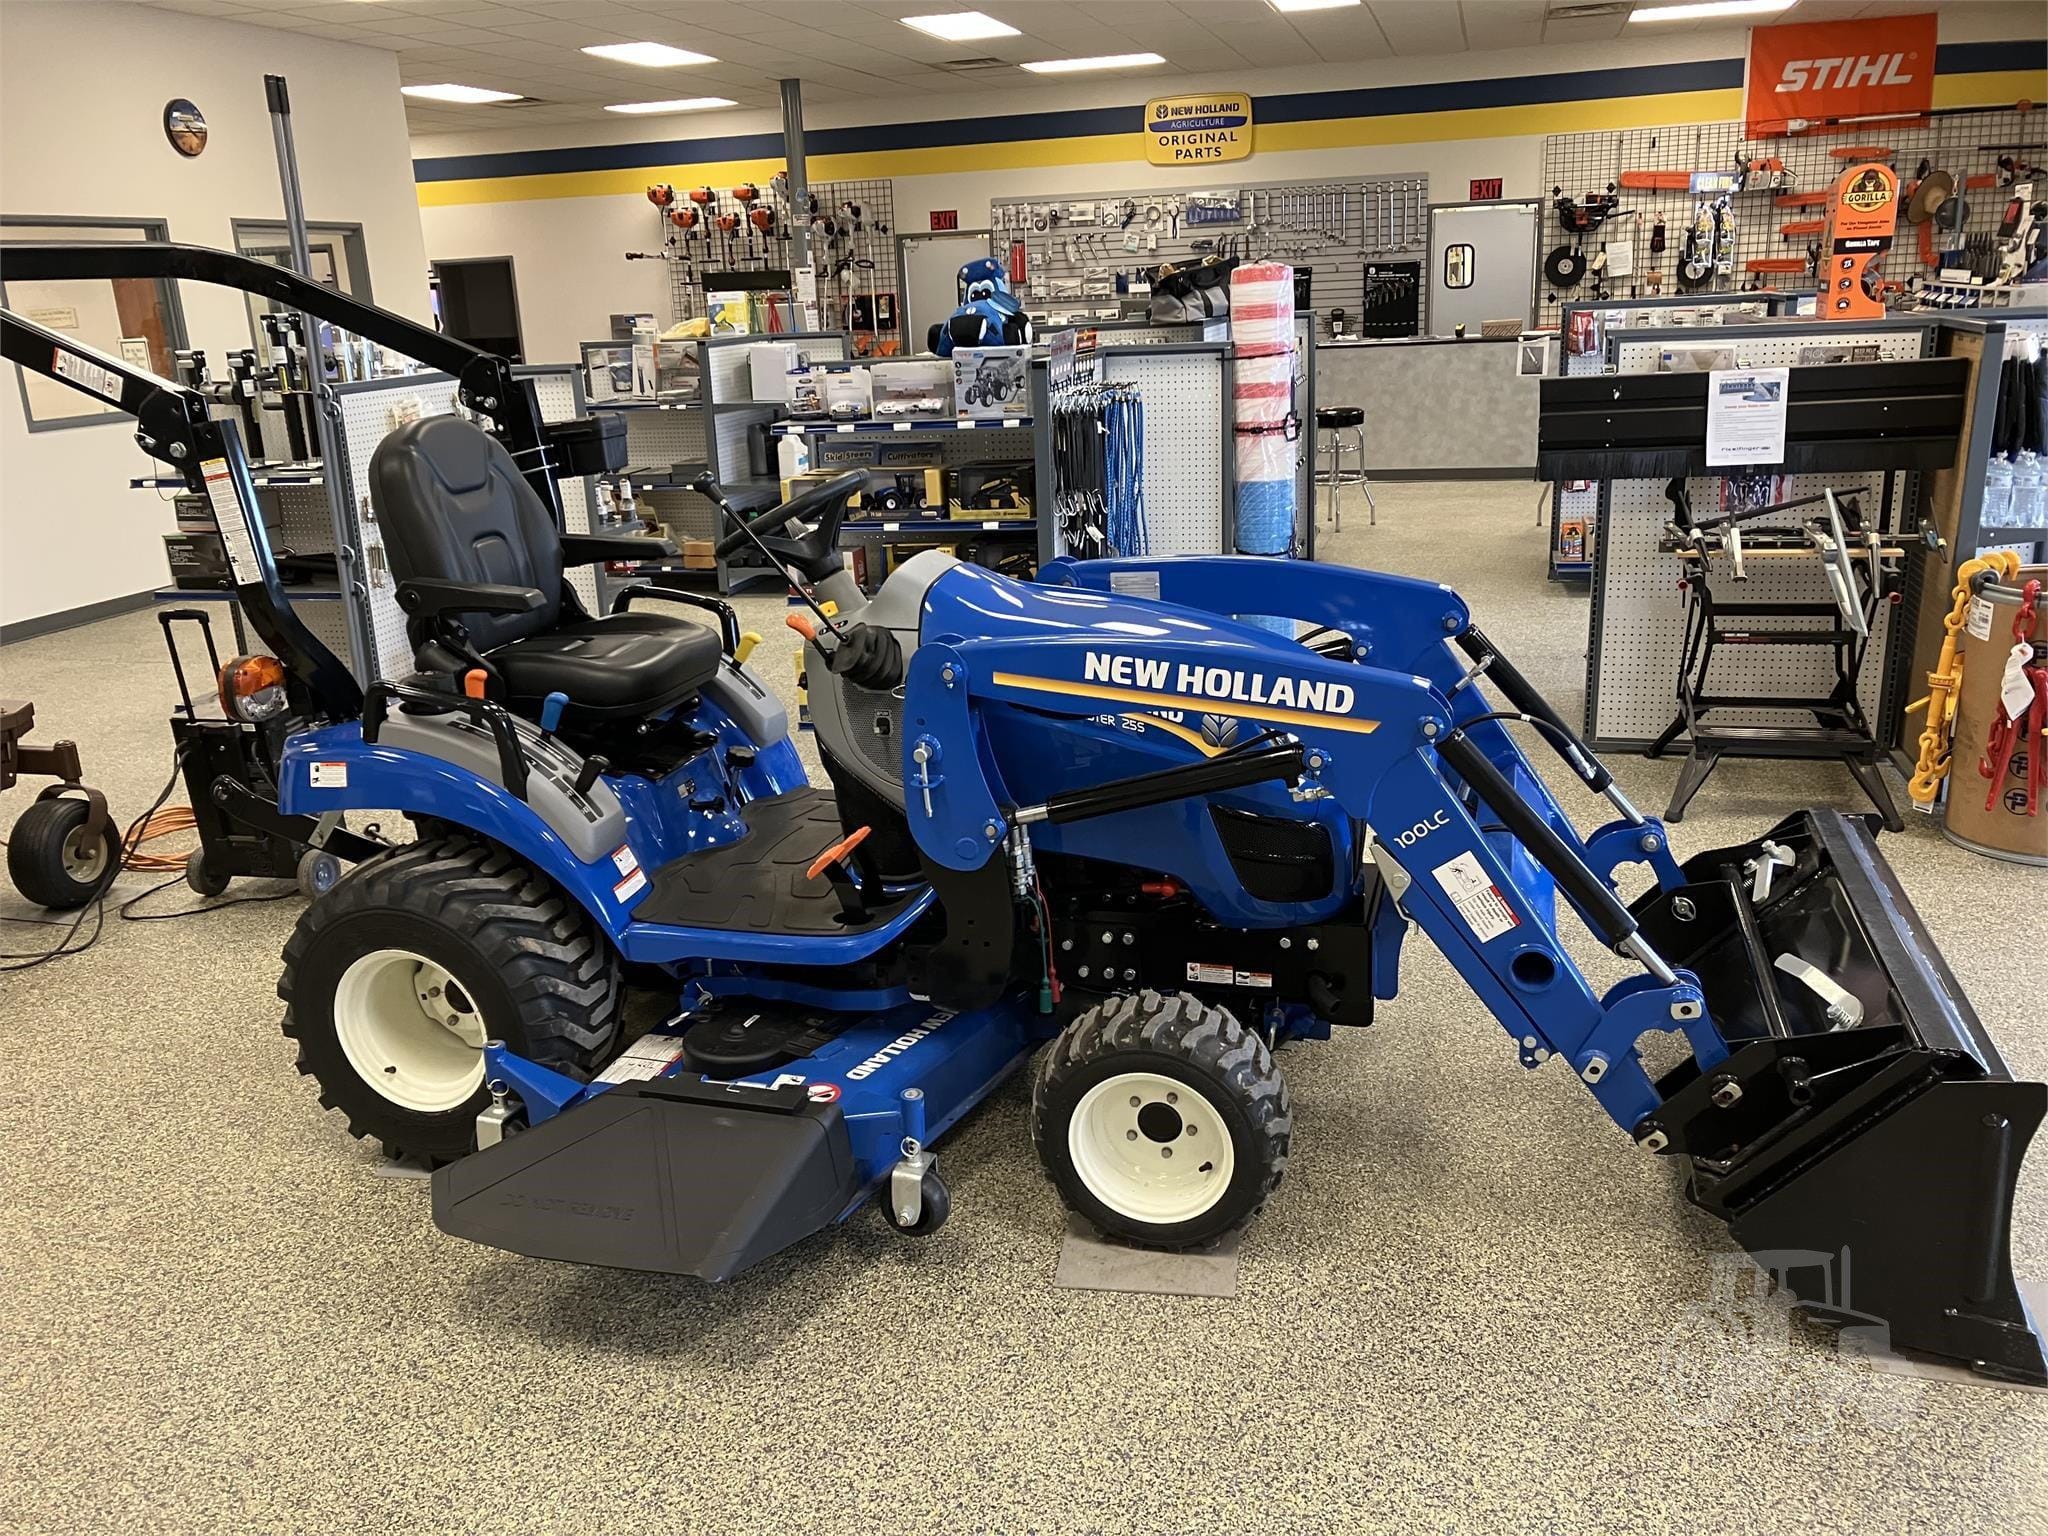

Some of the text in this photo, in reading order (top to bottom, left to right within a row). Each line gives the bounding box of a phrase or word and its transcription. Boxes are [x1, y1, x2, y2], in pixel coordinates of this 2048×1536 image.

[1775, 53, 1913, 93] STIHL
[1171, 103, 1240, 117] NEW HOLLAND
[1170, 118, 1225, 129] AGRICULTURE
[1159, 131, 1238, 147] ORIGINAL
[1175, 146, 1222, 160] PARTS
[1471, 179, 1502, 200] EXIT
[1847, 192, 1888, 203] GORILLA
[931, 211, 957, 230] EXIT
[824, 450, 874, 462] Skid Steers
[886, 451, 935, 461] Cultivators
[1084, 651, 1356, 715] NEW HOLLAND
[1121, 718, 1146, 733] 25S
[1393, 808, 1451, 849] 100LC
[845, 1028, 931, 1081] HOLLAND
